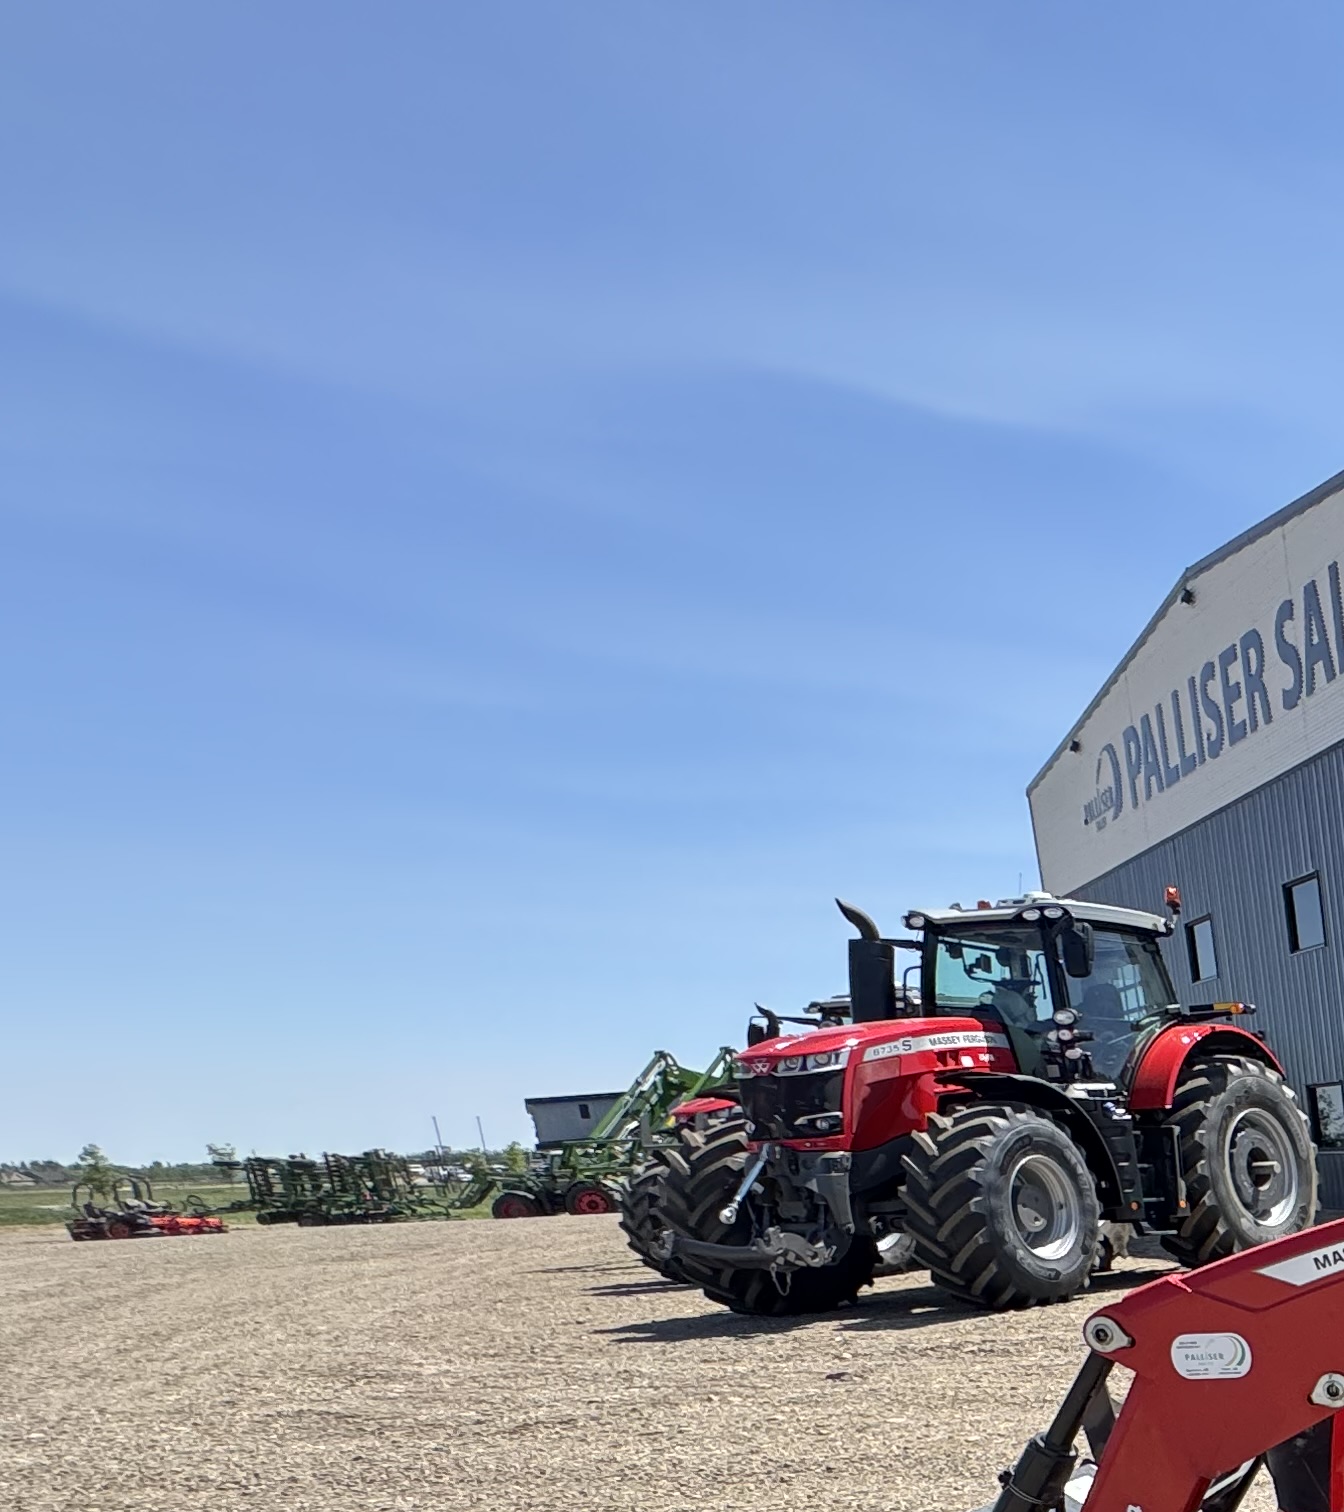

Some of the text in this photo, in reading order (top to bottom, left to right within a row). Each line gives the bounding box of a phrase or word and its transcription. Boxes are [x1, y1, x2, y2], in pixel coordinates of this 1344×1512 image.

[1122, 627, 1273, 810] PALLISER
[902, 1040, 912, 1050] S
[929, 1034, 961, 1046] MASSEY
[1184, 1352, 1225, 1361] PALLISER
